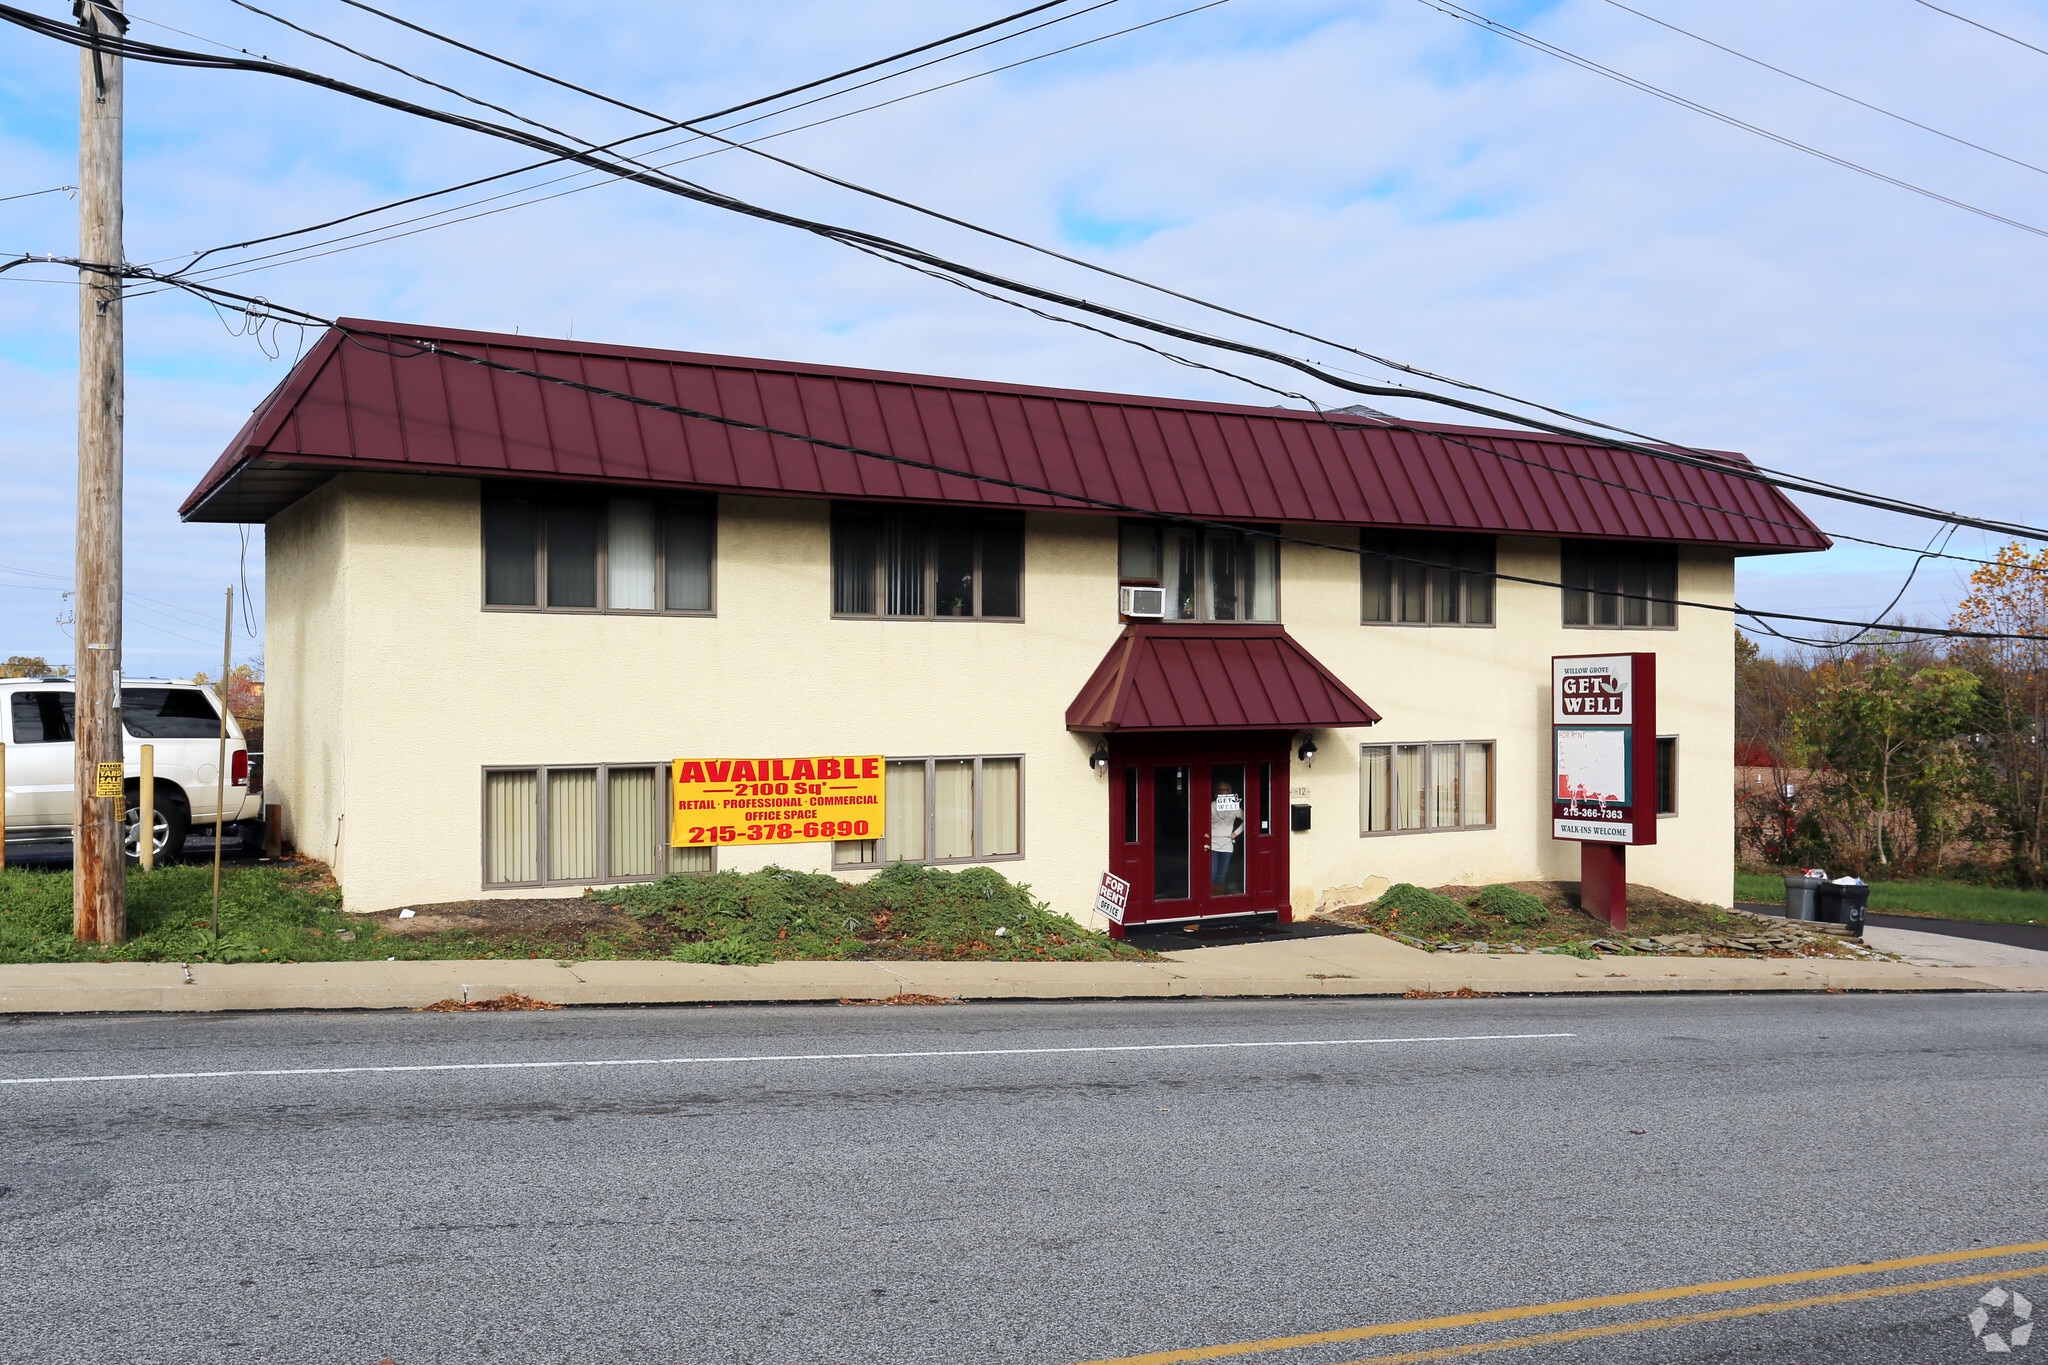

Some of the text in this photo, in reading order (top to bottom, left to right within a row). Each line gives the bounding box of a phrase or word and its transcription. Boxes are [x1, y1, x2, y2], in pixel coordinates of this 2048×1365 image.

[1563, 677, 1603, 694] GET
[1563, 697, 1621, 713] WELL
[679, 758, 879, 783] AVAILABLE
[735, 783, 788, 796] 2100
[679, 795, 878, 810] RETAIL PROFESSIONAL COMMERCIAL
[745, 809, 817, 821] OFFICE SPACE
[1563, 807, 1623, 819] 215-366-7363
[688, 820, 869, 843] 215-378-6890
[1561, 824, 1627, 837] WALK-INS WELCOME
[1105, 876, 1125, 895] FOR
[1100, 885, 1125, 907] RENT
[1100, 900, 1119, 918] OFFICE
